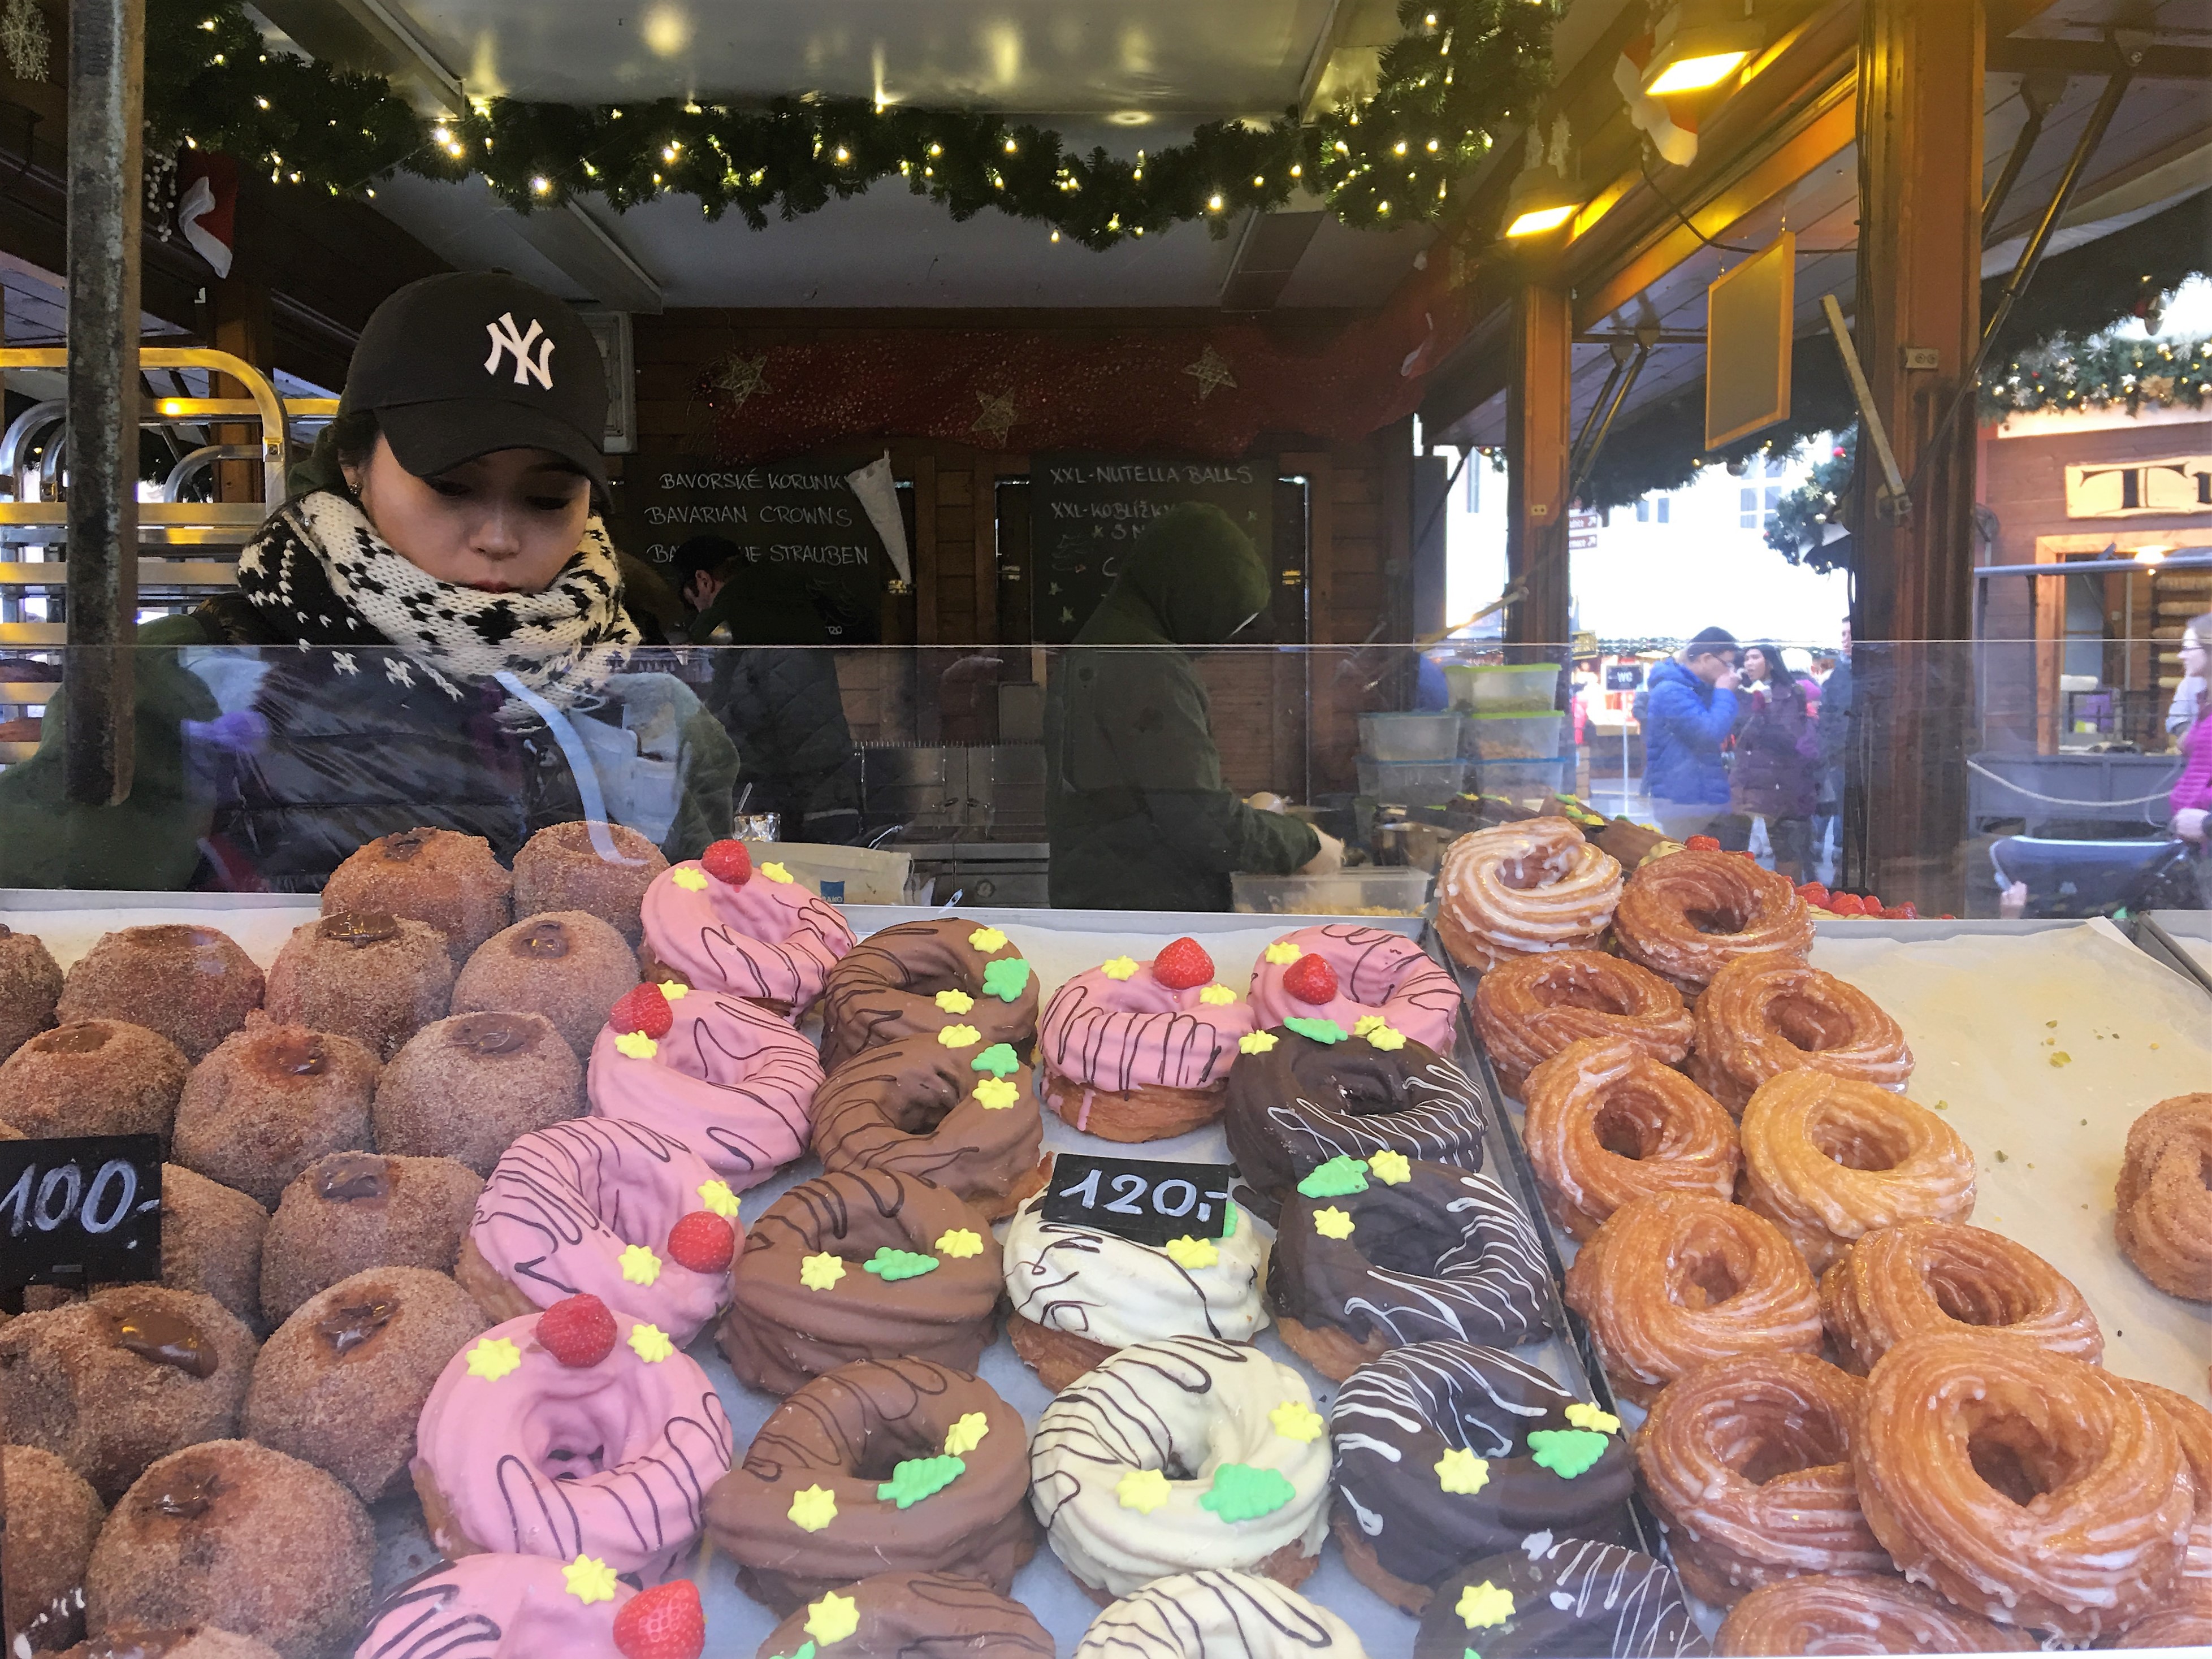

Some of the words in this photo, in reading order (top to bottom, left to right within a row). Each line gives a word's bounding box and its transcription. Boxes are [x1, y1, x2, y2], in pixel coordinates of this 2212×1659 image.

[483, 311, 556, 391] NY
[659, 467, 763, 490] BAVORSKÉ
[1182, 465, 1253, 484] BALLS
[643, 505, 748, 525] BAVARIAN
[759, 505, 853, 527] CROWNS
[769, 544, 869, 565] STRAUBEN
[1617, 672, 1633, 683] WC
[1059, 1169, 1228, 1222] 120,-
